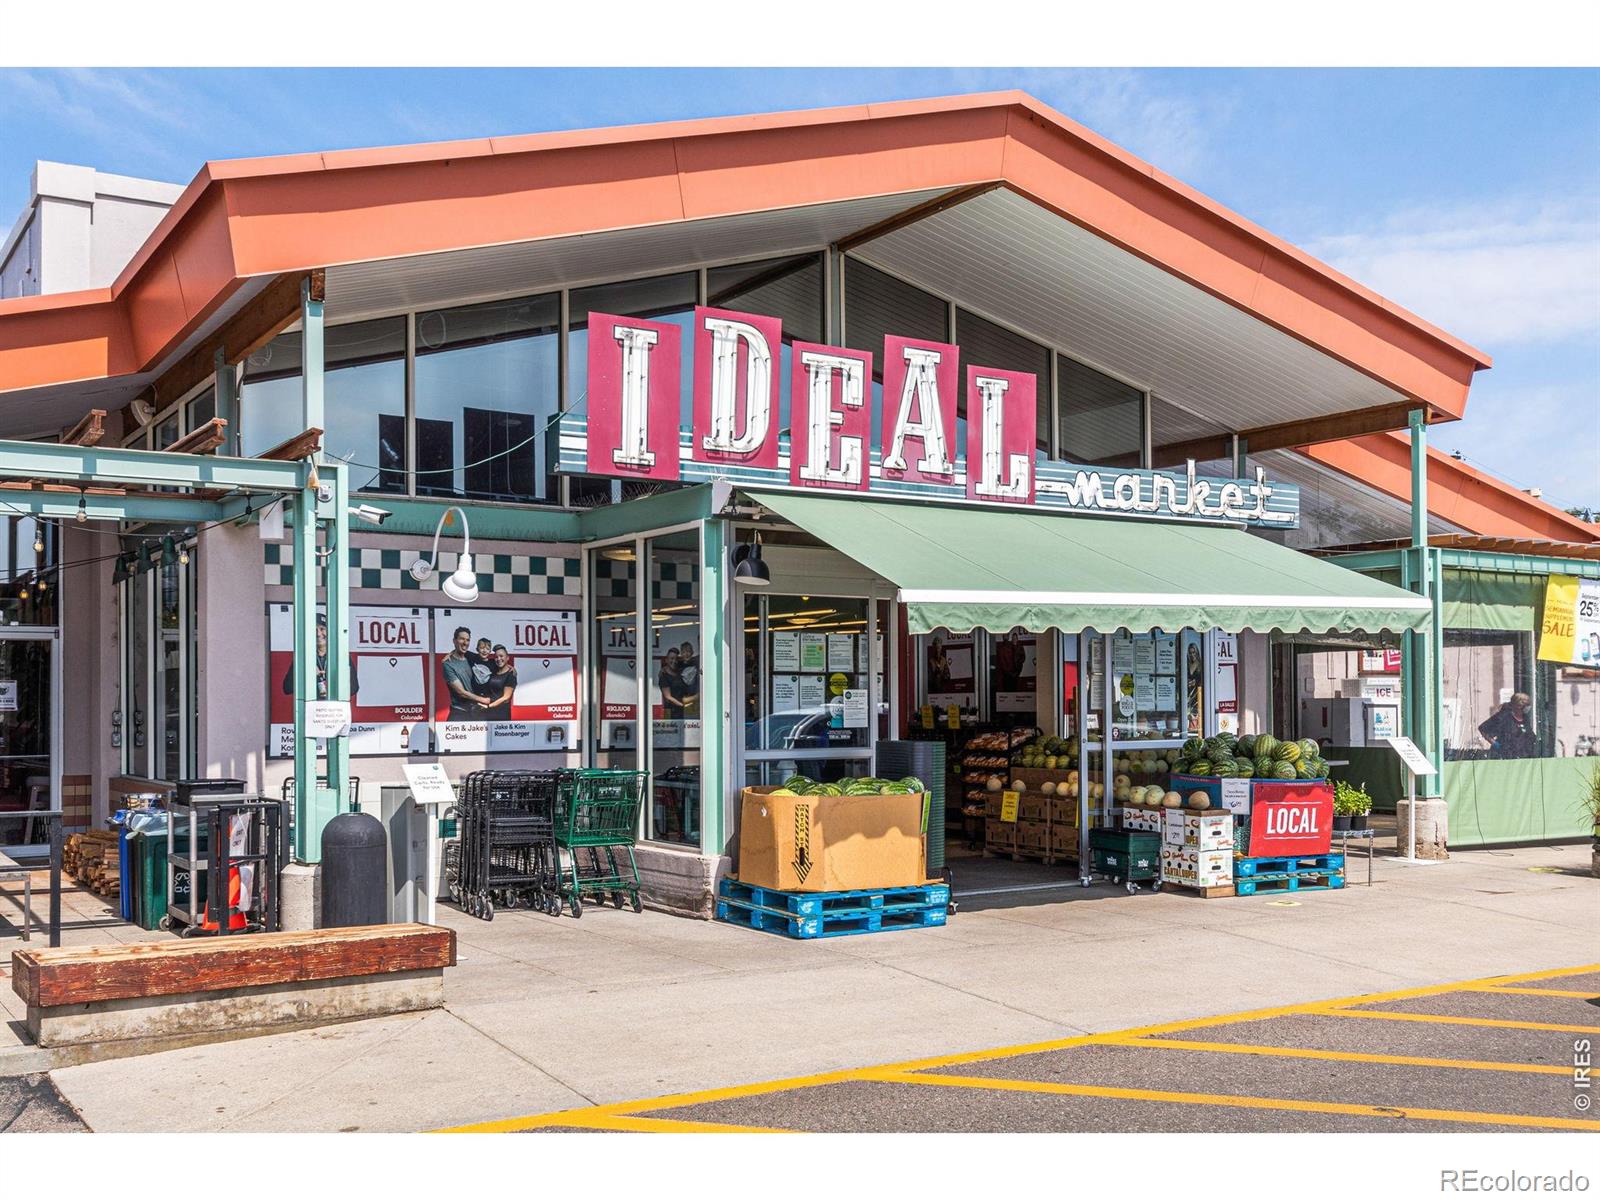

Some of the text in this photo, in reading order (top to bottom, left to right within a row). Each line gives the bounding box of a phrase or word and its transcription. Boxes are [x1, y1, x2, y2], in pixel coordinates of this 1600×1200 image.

[612, 317, 1031, 499] IDEAL
[1038, 458, 1296, 522] market
[358, 620, 421, 645] LOCAL
[514, 624, 571, 647] LOCAL
[1542, 619, 1575, 638] SALE
[1376, 687, 1392, 698] ICE
[1266, 805, 1319, 835] LOCAL
